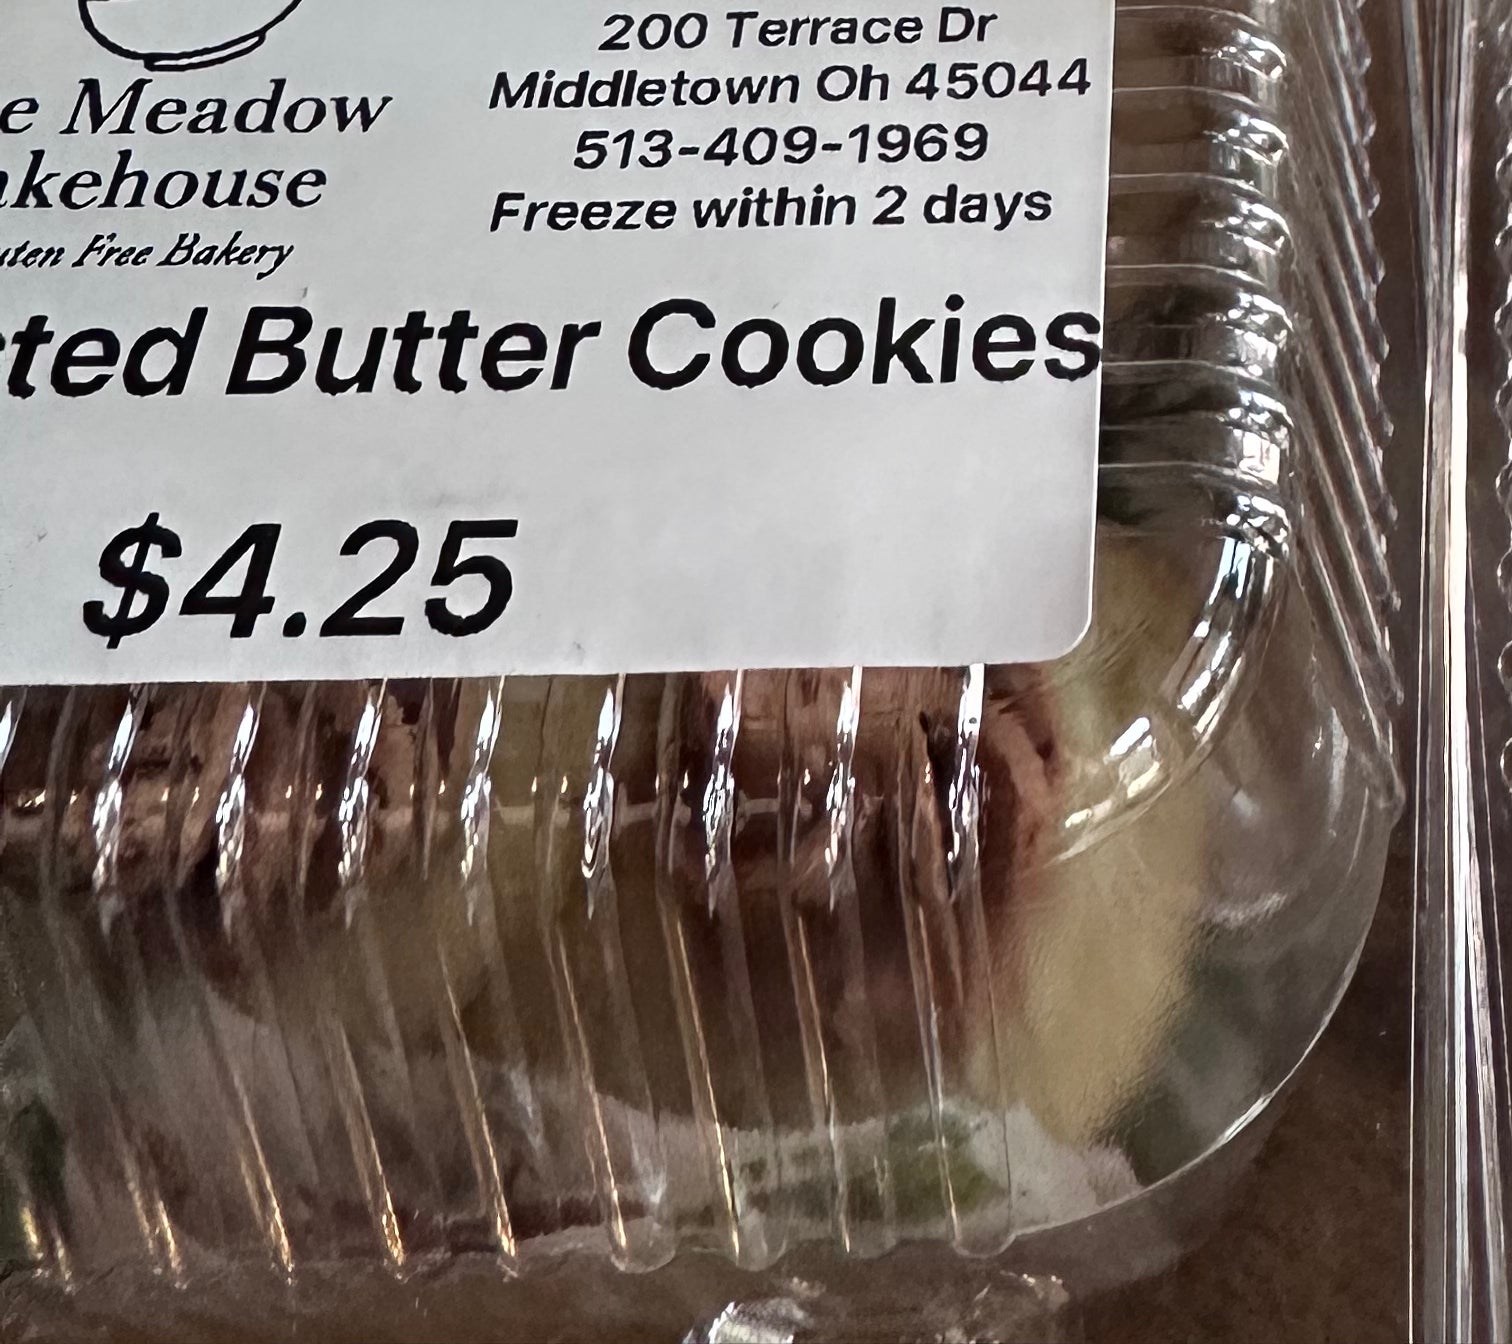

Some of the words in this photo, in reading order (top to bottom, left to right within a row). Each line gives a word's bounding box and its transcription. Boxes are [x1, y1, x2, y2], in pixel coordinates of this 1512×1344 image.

[597, 12, 709, 51] 200
[725, 11, 924, 49] Terrace
[938, 6, 999, 43] Dr
[58, 77, 394, 135] Meadow
[488, 69, 800, 110] Middletown
[816, 63, 890, 102] Oh
[905, 57, 1091, 101] 45044
[573, 122, 989, 170] 513-409-1969
[489, 191, 677, 233] Freeze
[692, 183, 857, 229] within
[872, 185, 908, 226] 2
[923, 183, 1052, 232] days
[0, 240, 66, 269] ten
[71, 232, 154, 268] Free
[155, 230, 295, 281] Bakery
[0, 306, 209, 400] ted
[224, 305, 602, 397] Butter
[627, 293, 1102, 391] Cookies
[82, 511, 519, 650] $4.25
